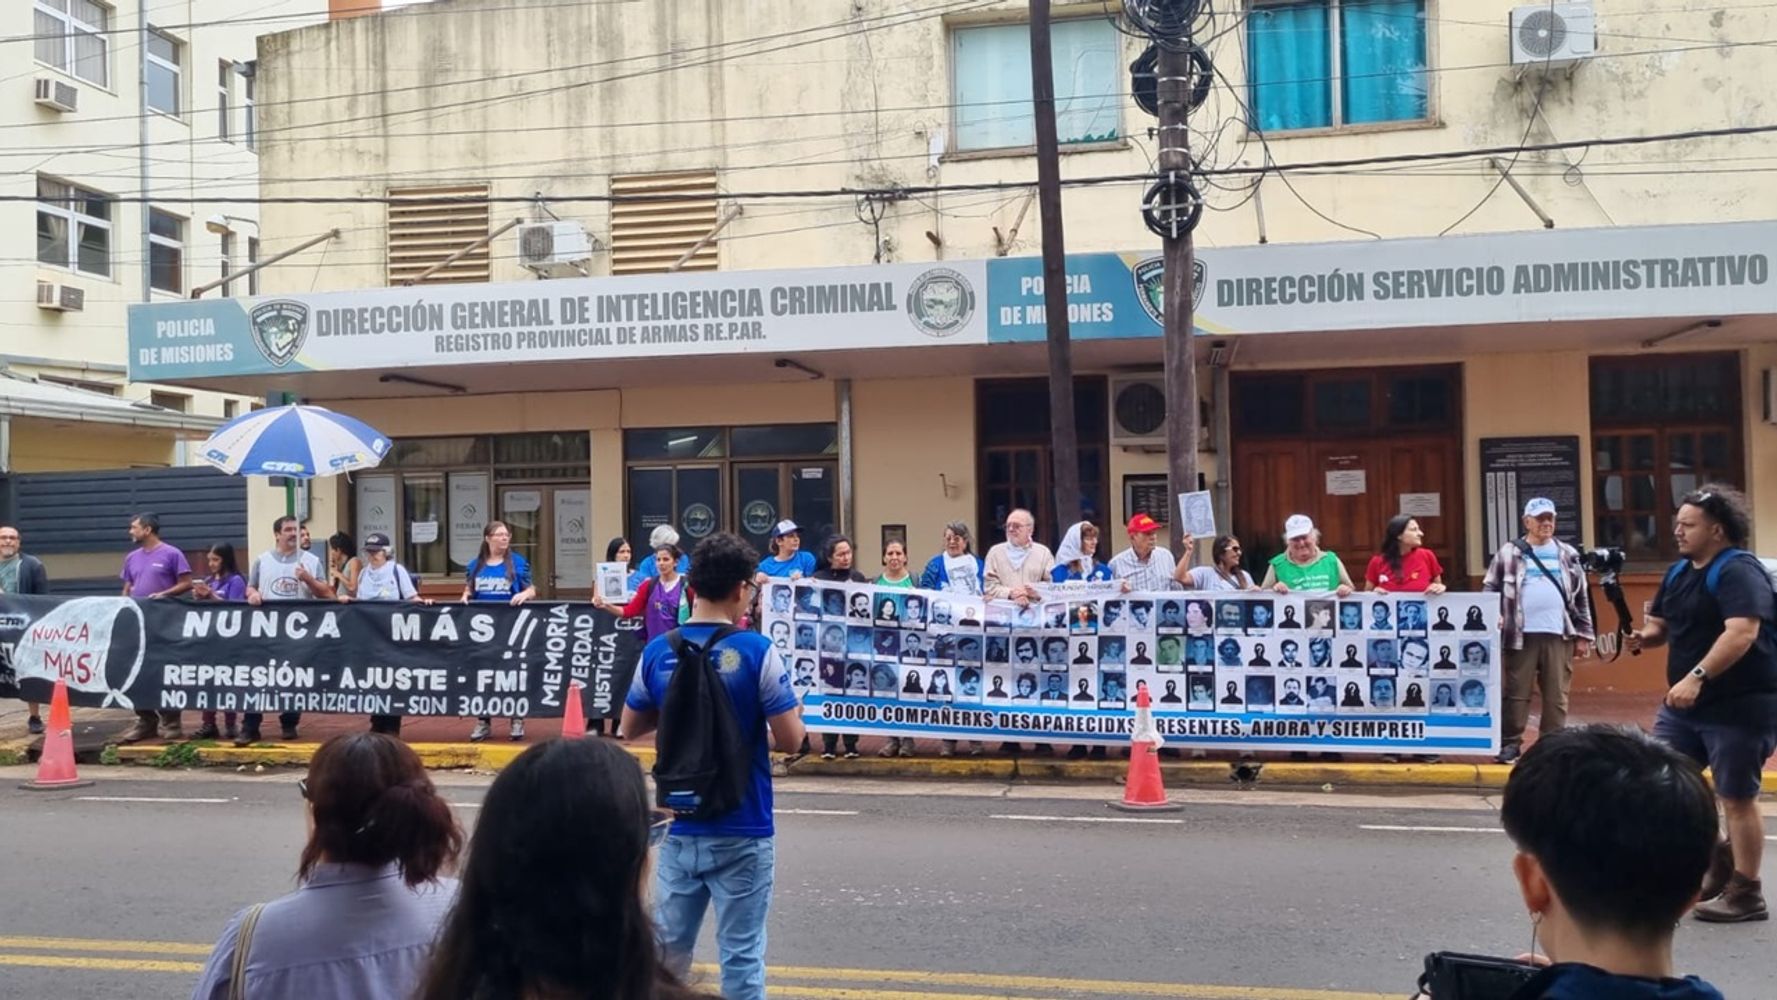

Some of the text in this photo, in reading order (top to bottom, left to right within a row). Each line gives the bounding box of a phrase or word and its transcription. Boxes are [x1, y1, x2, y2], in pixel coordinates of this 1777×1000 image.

[1021, 274, 1092, 296] POCIA
[1216, 268, 1365, 308] DIRECCIÓN
[1372, 265, 1505, 300] SERVICIO
[1513, 253, 1769, 295] ADMINISTRATIVO
[316, 299, 444, 337] DIRECCIÓN
[450, 298, 554, 330] GENERAL
[560, 296, 590, 325] DE
[597, 288, 764, 323] INTELIGENCIA
[770, 282, 897, 316] CRIMINAL
[1000, 306, 1022, 326] DE
[1026, 302, 1114, 325] MIONES
[156, 318, 216, 339] POLICIA
[434, 332, 513, 353] REGISTRO
[516, 328, 612, 349] PROVINCIAL
[617, 326, 637, 345] DE
[640, 324, 699, 344] ARMAS
[139, 349, 160, 366] DE
[161, 344, 234, 364] MISIONES
[32, 621, 90, 646] NUNCA
[182, 610, 341, 639] NUNCA
[339, 666, 448, 691] AJUSTE
[161, 689, 188, 709] NO
[196, 691, 208, 709] A
[216, 691, 238, 711] LA
[457, 696, 529, 716] 30.000
[822, 702, 1425, 739] 30000 COMPAÑERXS DESAPARECIDXS RESENTES, AHORA Y SIEMPRE!!
